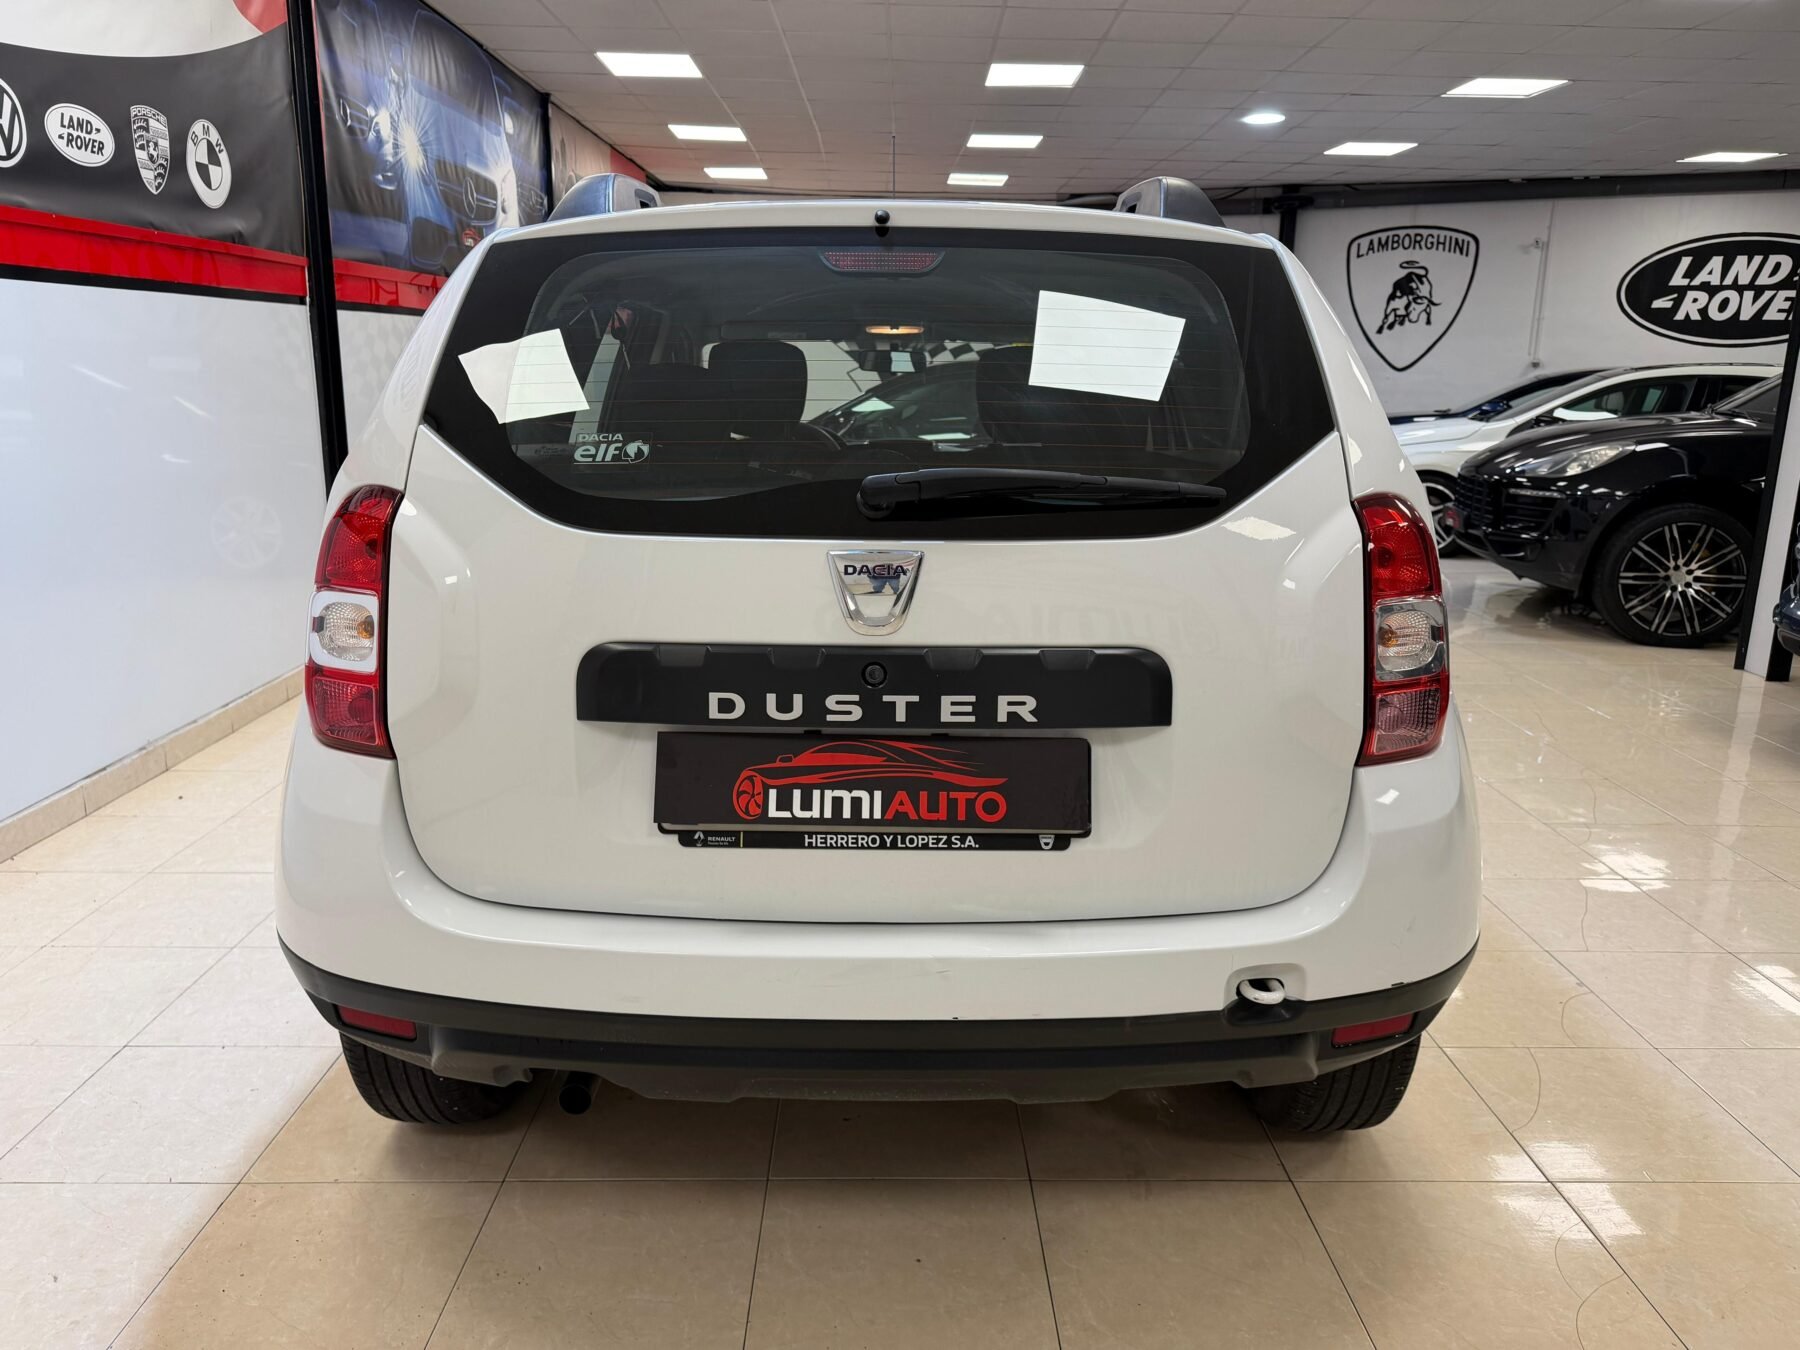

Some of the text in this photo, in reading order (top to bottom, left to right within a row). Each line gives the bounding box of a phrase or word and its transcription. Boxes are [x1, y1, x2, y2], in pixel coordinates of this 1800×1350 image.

[60, 112, 94, 135] LAND
[131, 107, 168, 128] PORSCHE
[66, 132, 105, 157] ROVER
[190, 123, 224, 154] BMW
[1356, 233, 1470, 259] LAMBORGHINI
[1668, 254, 1794, 286] LAND
[1673, 289, 1797, 321] ROVE
[577, 433, 624, 441] DACIA
[573, 443, 623, 462] elf
[843, 564, 907, 576] DACIA
[708, 692, 1039, 723] DUSTER
[804, 834, 980, 848] HERRERO Y LOPEZ S.A.
